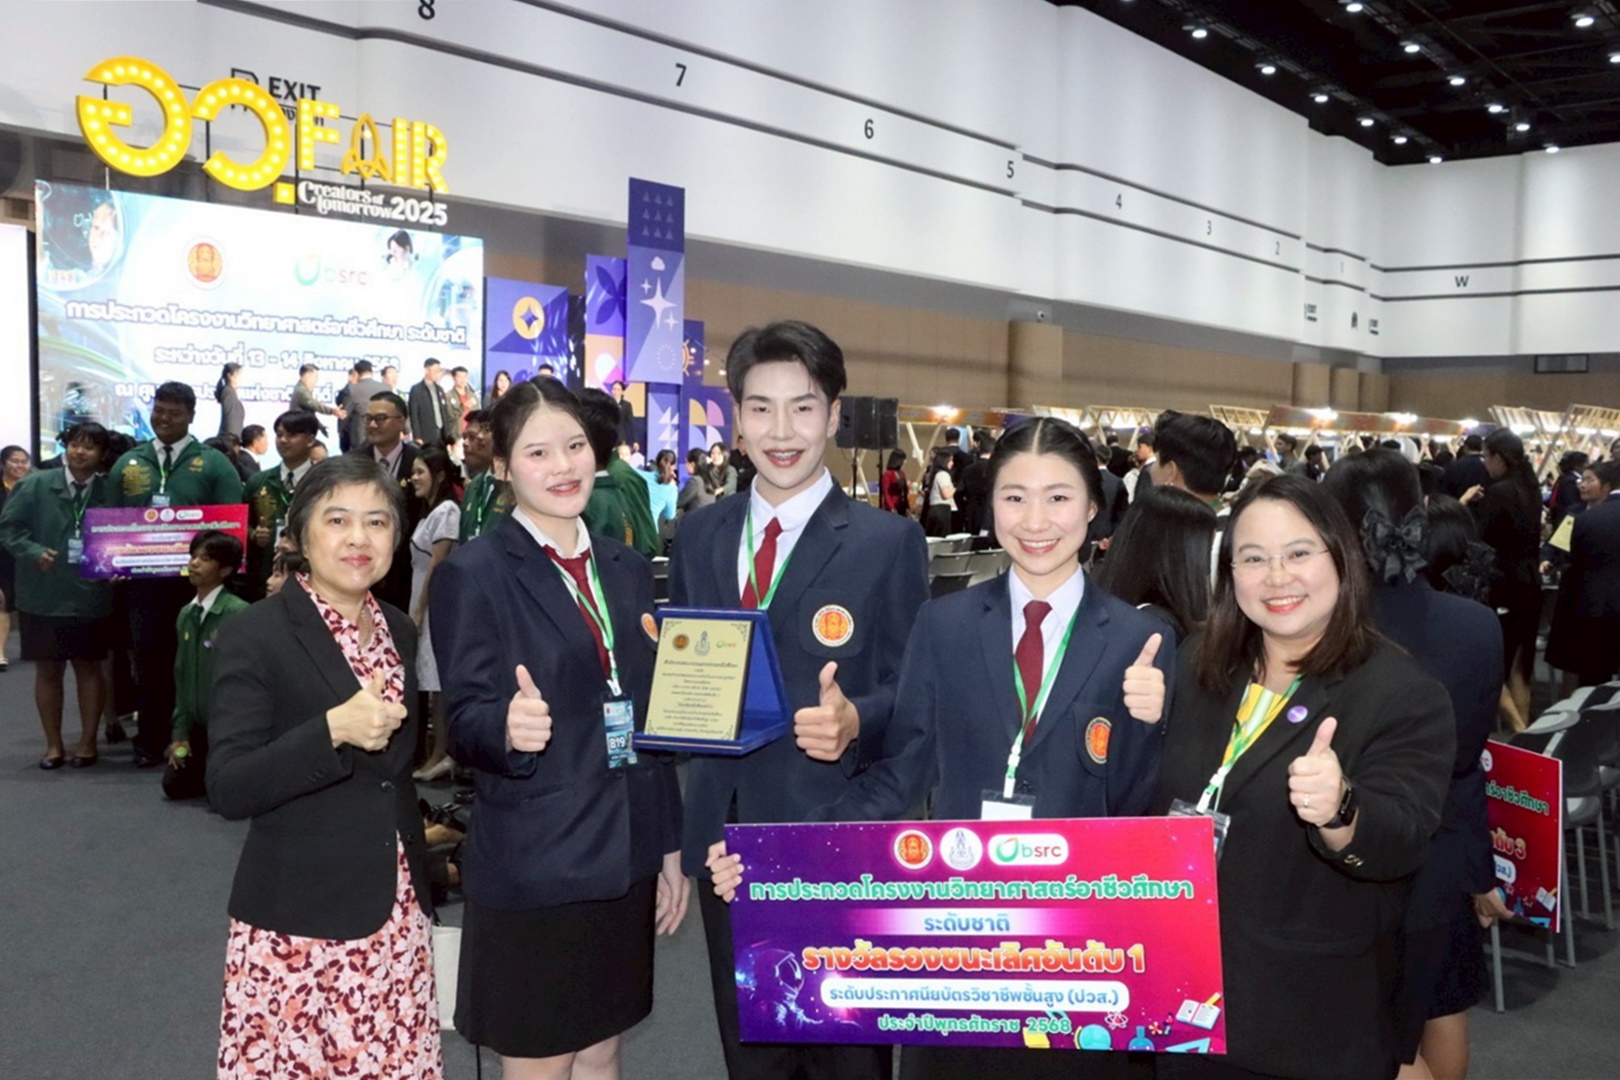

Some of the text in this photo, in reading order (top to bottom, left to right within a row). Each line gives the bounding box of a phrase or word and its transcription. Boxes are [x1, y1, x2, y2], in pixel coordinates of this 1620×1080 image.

[675, 63, 687, 87] 7
[269, 76, 321, 102] EXIT
[864, 119, 874, 139] 6
[1006, 160, 1014, 178] 5
[298, 181, 371, 204] Creators
[1115, 193, 1122, 209] 4
[390, 197, 448, 226] 2025
[1206, 220, 1212, 235] 3
[324, 262, 368, 286] bsrc
[1455, 276, 1469, 287] W
[247, 347, 267, 368] 13
[280, 350, 300, 370] 14
[1021, 843, 1062, 858] bsrc
[1515, 837, 1527, 860] 3
[749, 873, 1195, 900] การประกวดโครงงานวิทยาศาสตร์อาชีวศึกษา
[923, 911, 1010, 932] ระดับชาติ
[802, 938, 1146, 973] รางวัลรองชนะเลิศอันดับ 1
[829, 982, 1119, 1008] ระดับประกาศนียบัตรวิชาชีพชั้นสูง (ปวส.)
[877, 1013, 1072, 1036] ประจำปีพุทธศักราช 2568
